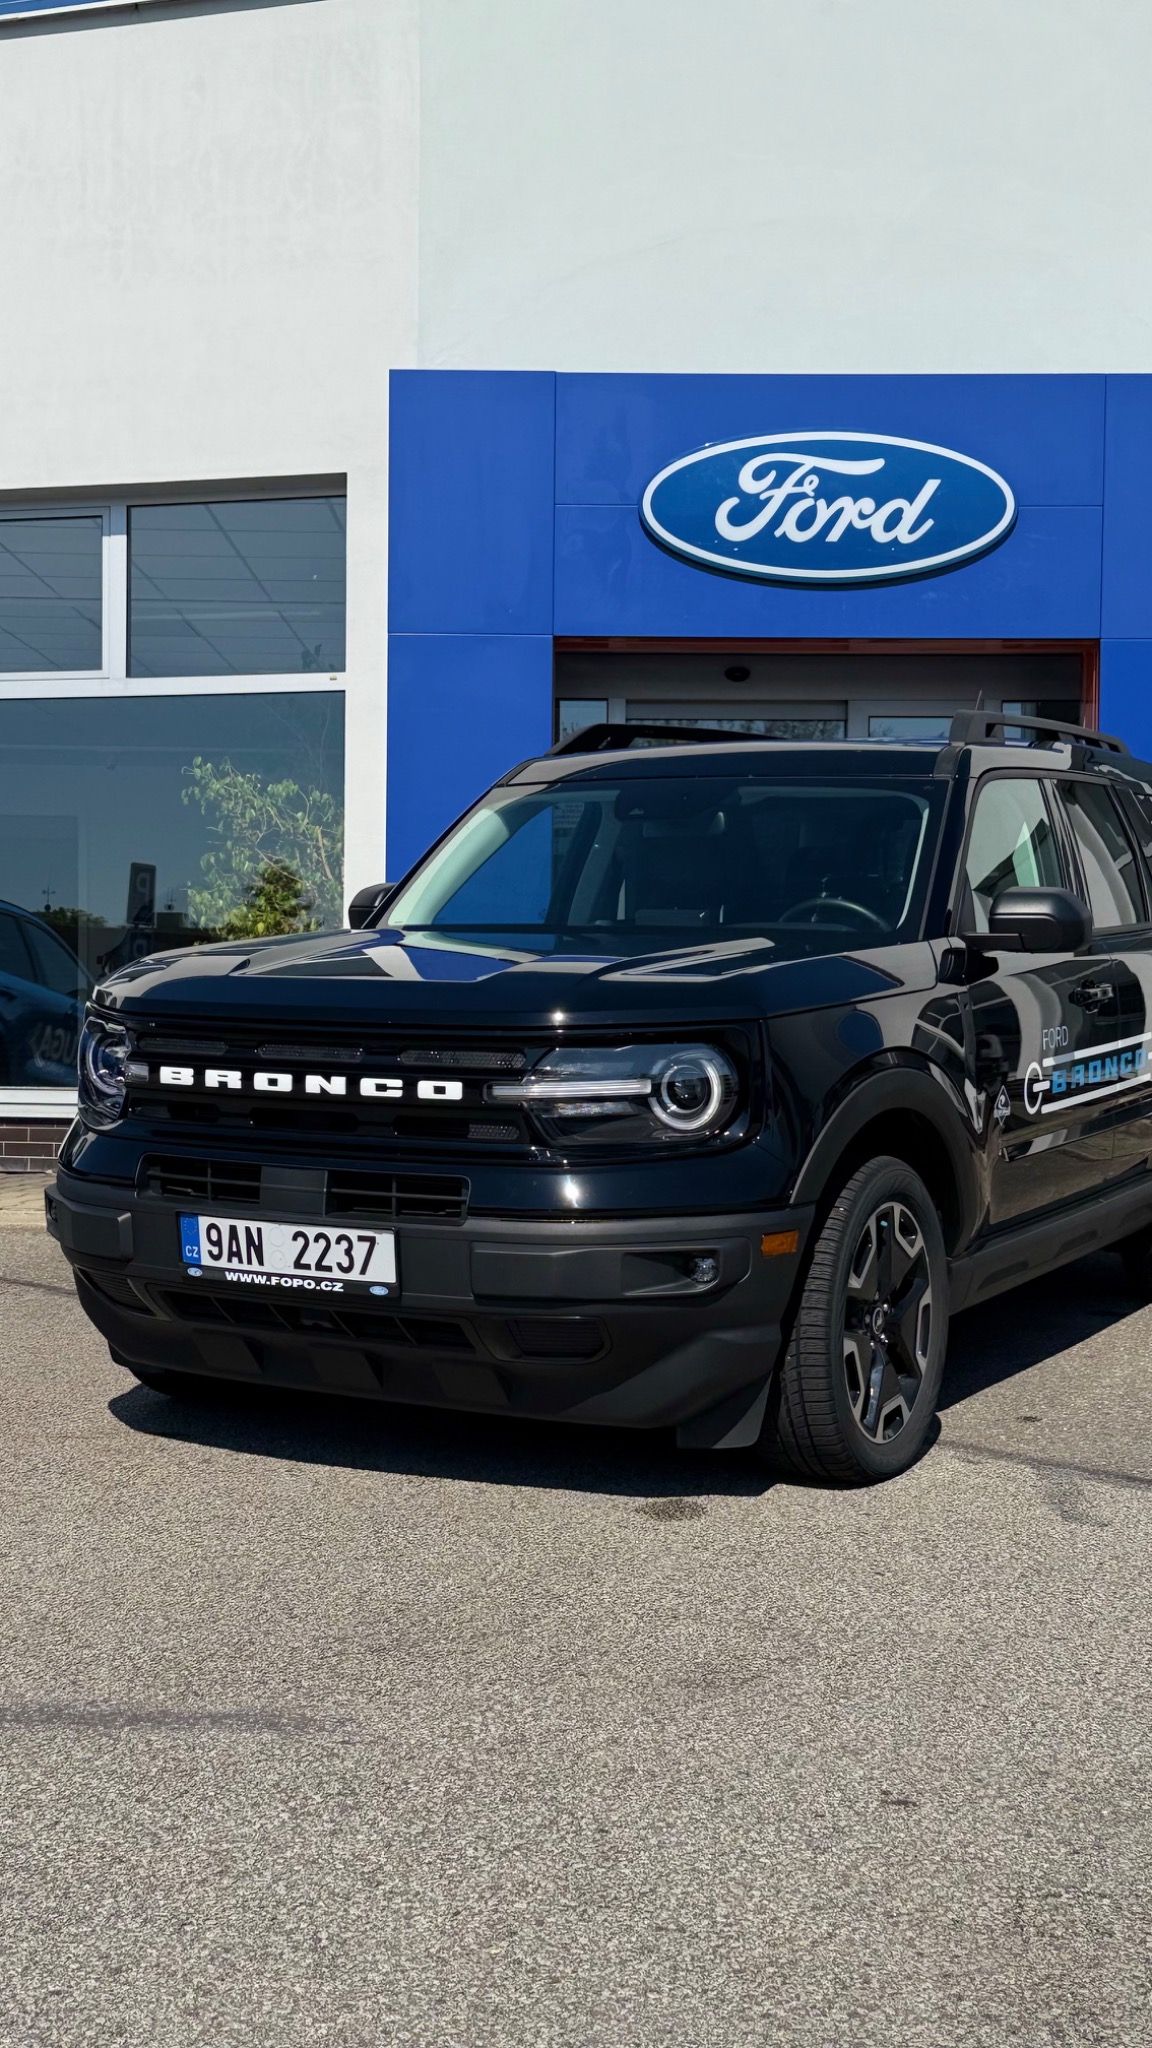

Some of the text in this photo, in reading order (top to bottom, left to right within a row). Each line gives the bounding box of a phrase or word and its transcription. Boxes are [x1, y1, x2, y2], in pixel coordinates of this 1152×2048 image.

[715, 452, 941, 544] Ford
[1042, 1025, 1069, 1051] FORD
[159, 1066, 463, 1100] BRONCO
[1051, 1047, 1147, 1094] BRONCO
[185, 1245, 199, 1258] CZ
[205, 1222, 377, 1275] 9AN 2237
[224, 1271, 344, 1292] WWW.FOPO.CZ
